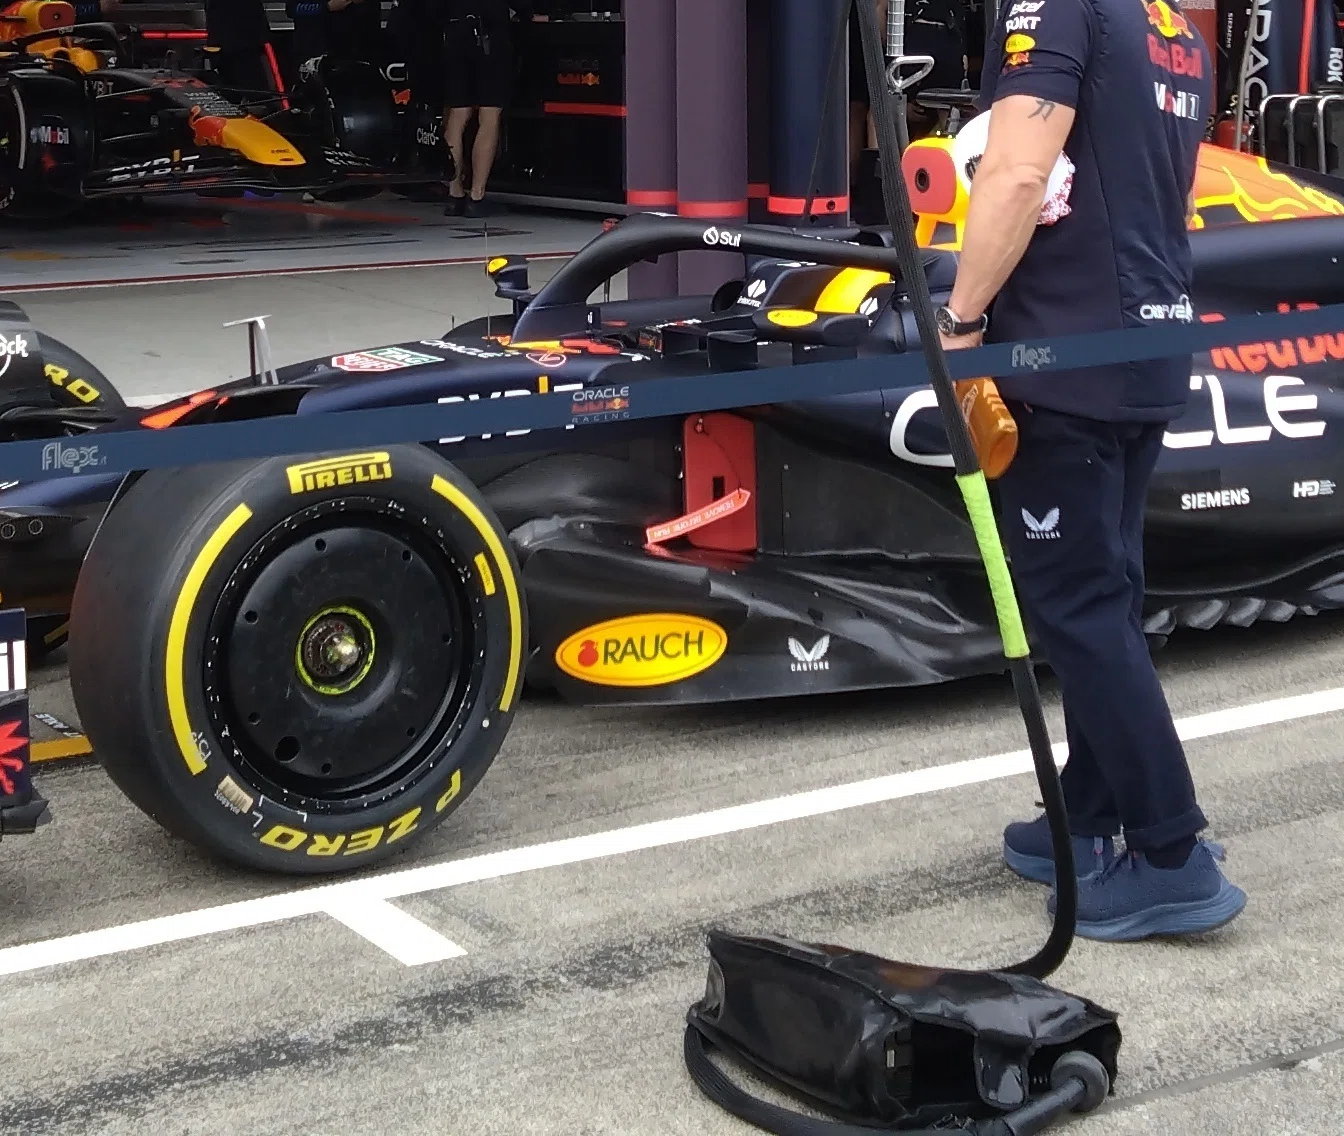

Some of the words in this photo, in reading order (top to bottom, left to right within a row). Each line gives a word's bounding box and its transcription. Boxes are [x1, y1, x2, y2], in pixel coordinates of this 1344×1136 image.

[1327, 46, 1344, 83] ROK
[572, 386, 630, 402] ORACLE
[41, 442, 99, 475] flex
[286, 451, 393, 495] PIRELLI
[1181, 488, 1251, 511] SIEMENS
[603, 631, 704, 666] RAUCH
[259, 806, 423, 858] ZERO
